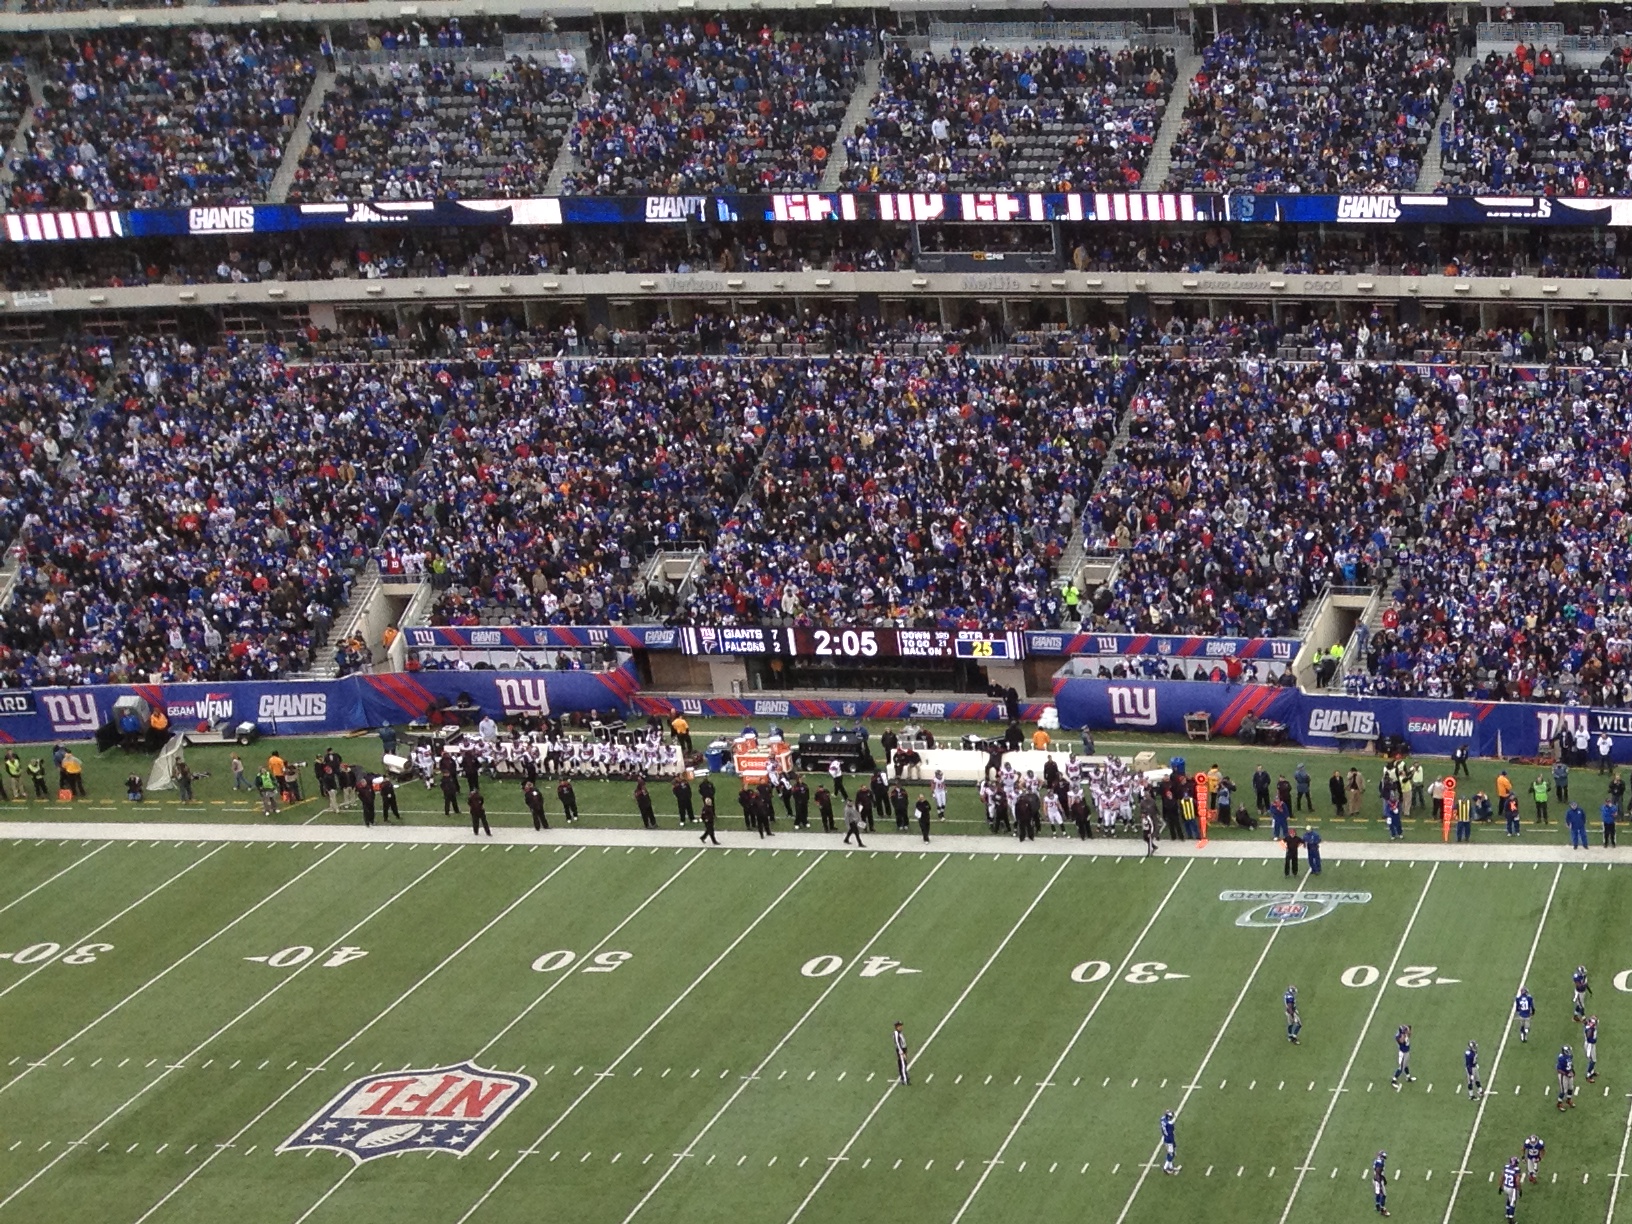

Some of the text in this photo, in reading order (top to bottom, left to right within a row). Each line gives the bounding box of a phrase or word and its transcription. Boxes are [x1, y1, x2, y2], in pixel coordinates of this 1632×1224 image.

[189, 206, 254, 233] GIANTS
[963, 277, 1019, 290] MetLife
[1304, 279, 1343, 295] pepsi
[471, 630, 501, 644] GIANTS
[645, 630, 676, 644] GIANTS
[724, 629, 763, 639] GIANTS
[771, 629, 778, 639] 7
[814, 631, 878, 656] 2:05
[902, 632, 931, 640] DOWN
[959, 632, 983, 640] QTR
[1032, 637, 1062, 650] GIANTS
[725, 641, 781, 652] FALCONS 2
[972, 641, 993, 656] 25
[1206, 642, 1236, 656] GIANTS
[196, 693, 234, 719] WFAN
[258, 694, 327, 718] GIANTS
[754, 701, 789, 715] GIANTS
[1309, 709, 1376, 733] GIANTS
[1438, 712, 1474, 737] WFAN
[1303, 893, 1360, 901] WILD
[11, 941, 114, 966] 30
[266, 944, 370, 969] 40
[531, 949, 634, 974] 50
[800, 954, 902, 979] 40
[1070, 961, 1169, 986] 30
[1340, 965, 1440, 988] 20
[358, 1074, 511, 1119] NFL
